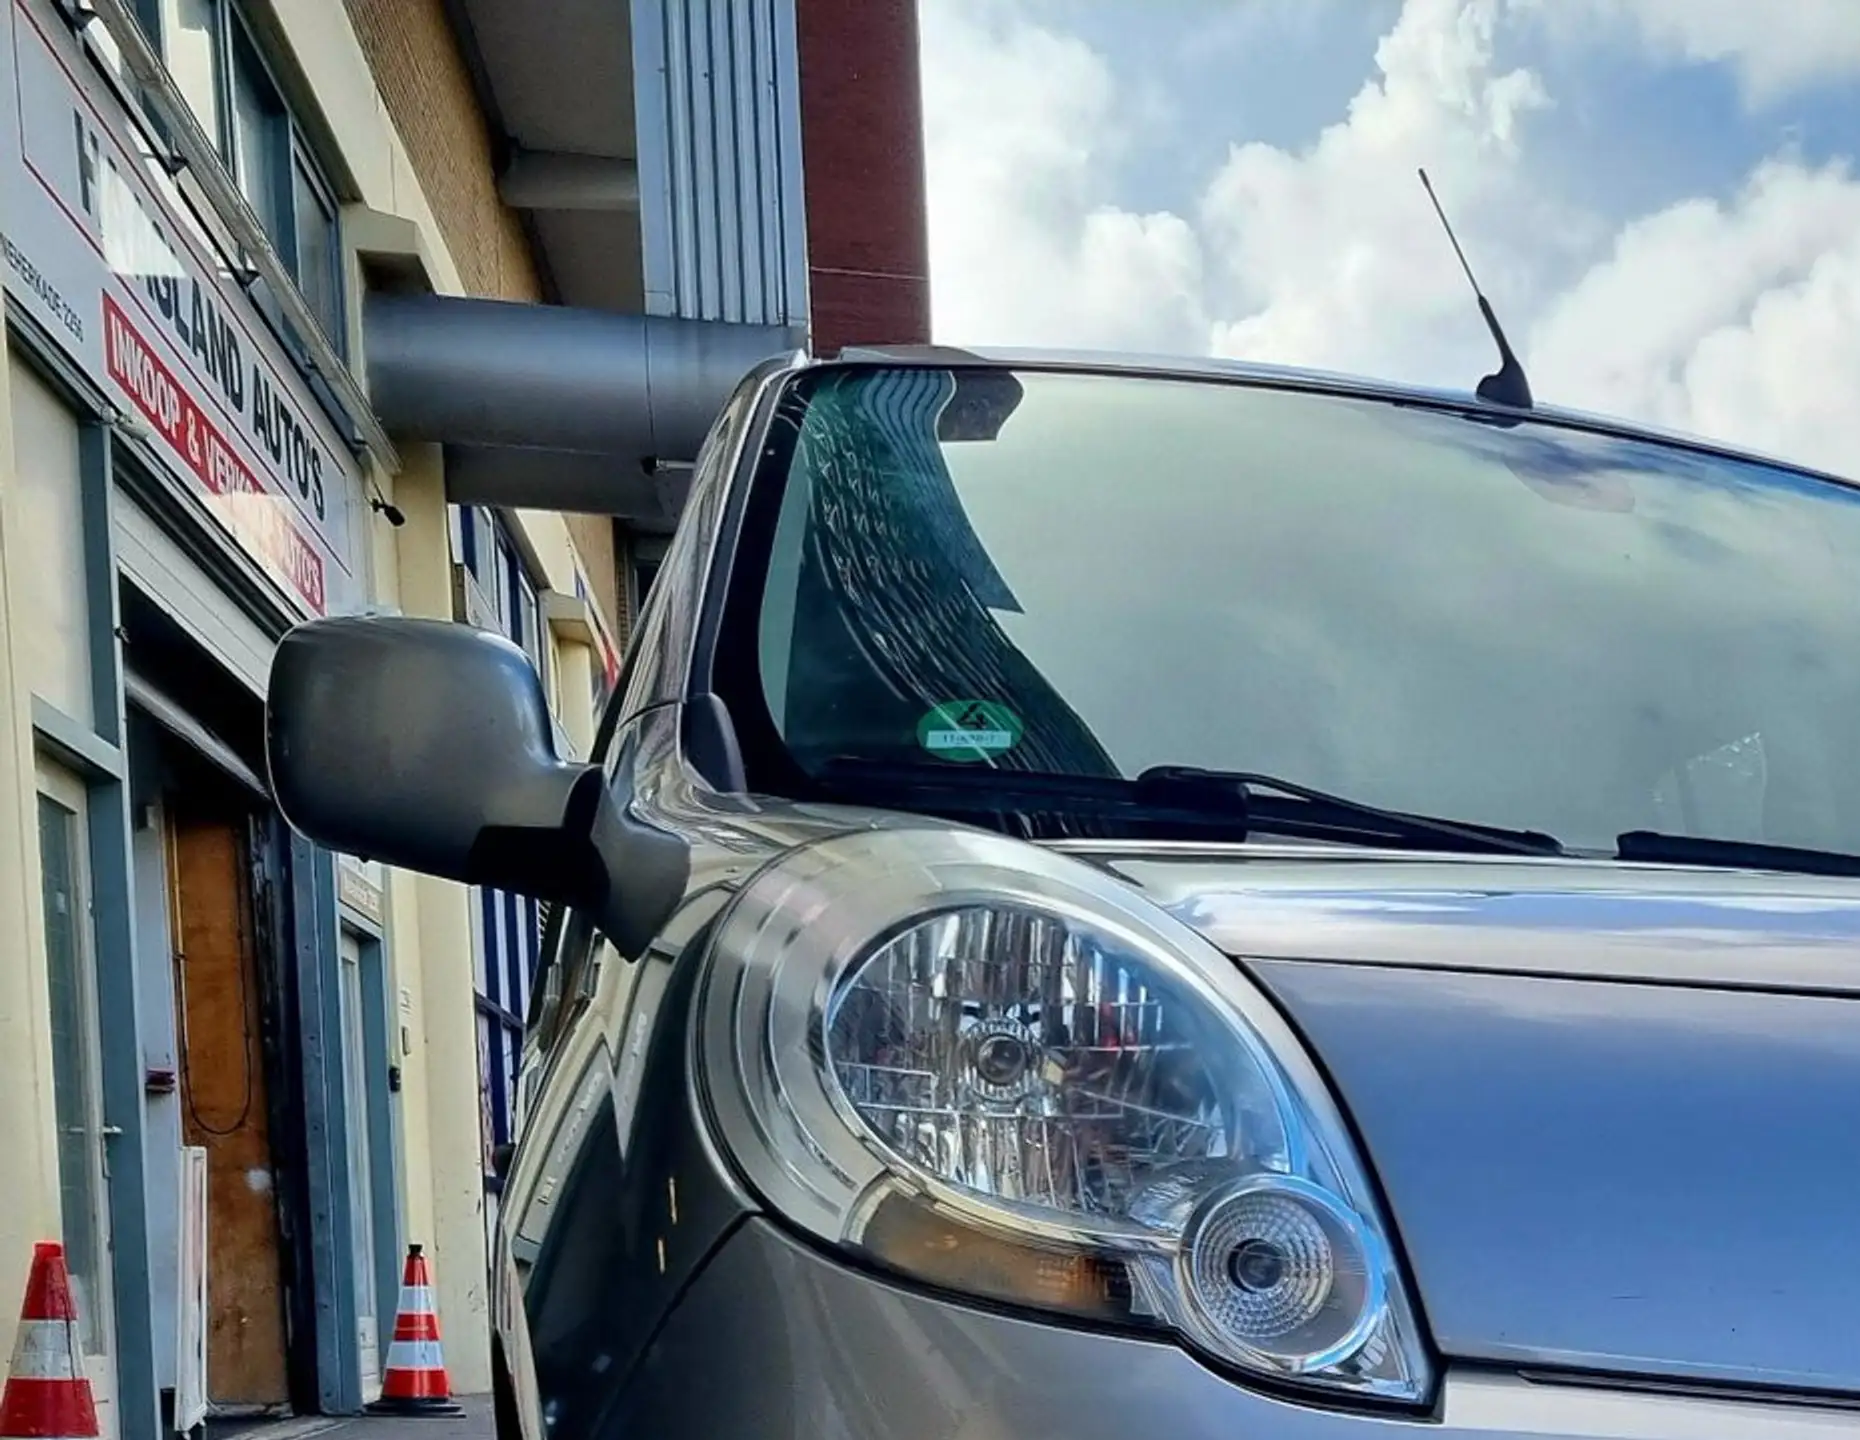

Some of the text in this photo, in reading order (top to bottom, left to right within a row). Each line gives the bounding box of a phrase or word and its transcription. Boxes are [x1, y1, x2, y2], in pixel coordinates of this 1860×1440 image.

[110, 309, 180, 441] INKOOP
[186, 409, 201, 468] &
[253, 363, 325, 523] AUTO'S
